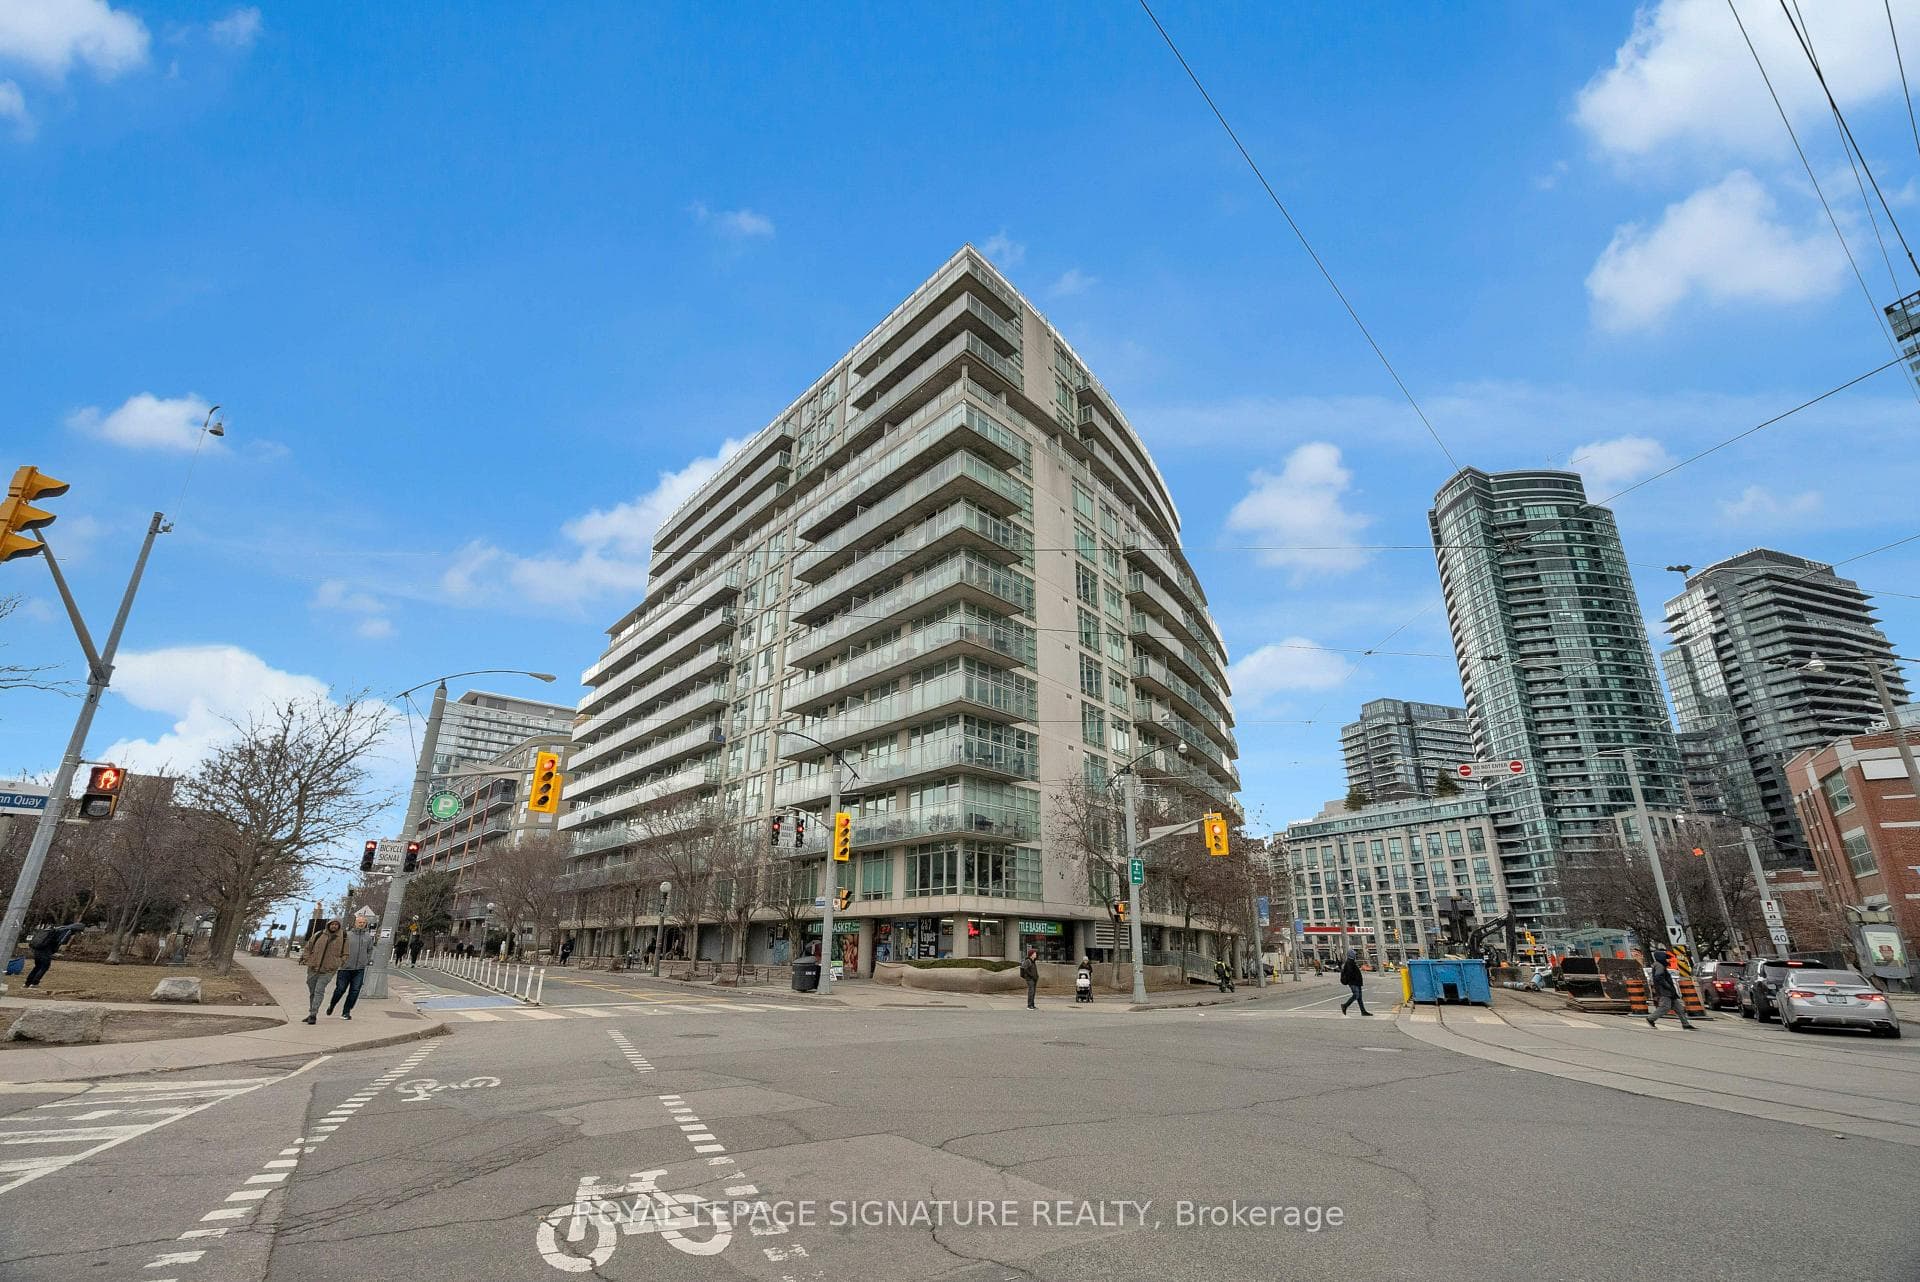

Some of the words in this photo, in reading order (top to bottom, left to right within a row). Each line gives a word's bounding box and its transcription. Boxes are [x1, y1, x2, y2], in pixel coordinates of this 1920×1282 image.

[14, 795, 42, 807] Quay
[438, 798, 453, 811] P
[379, 853, 400, 861] SIGNAL
[1029, 922, 1047, 933] BASKET
